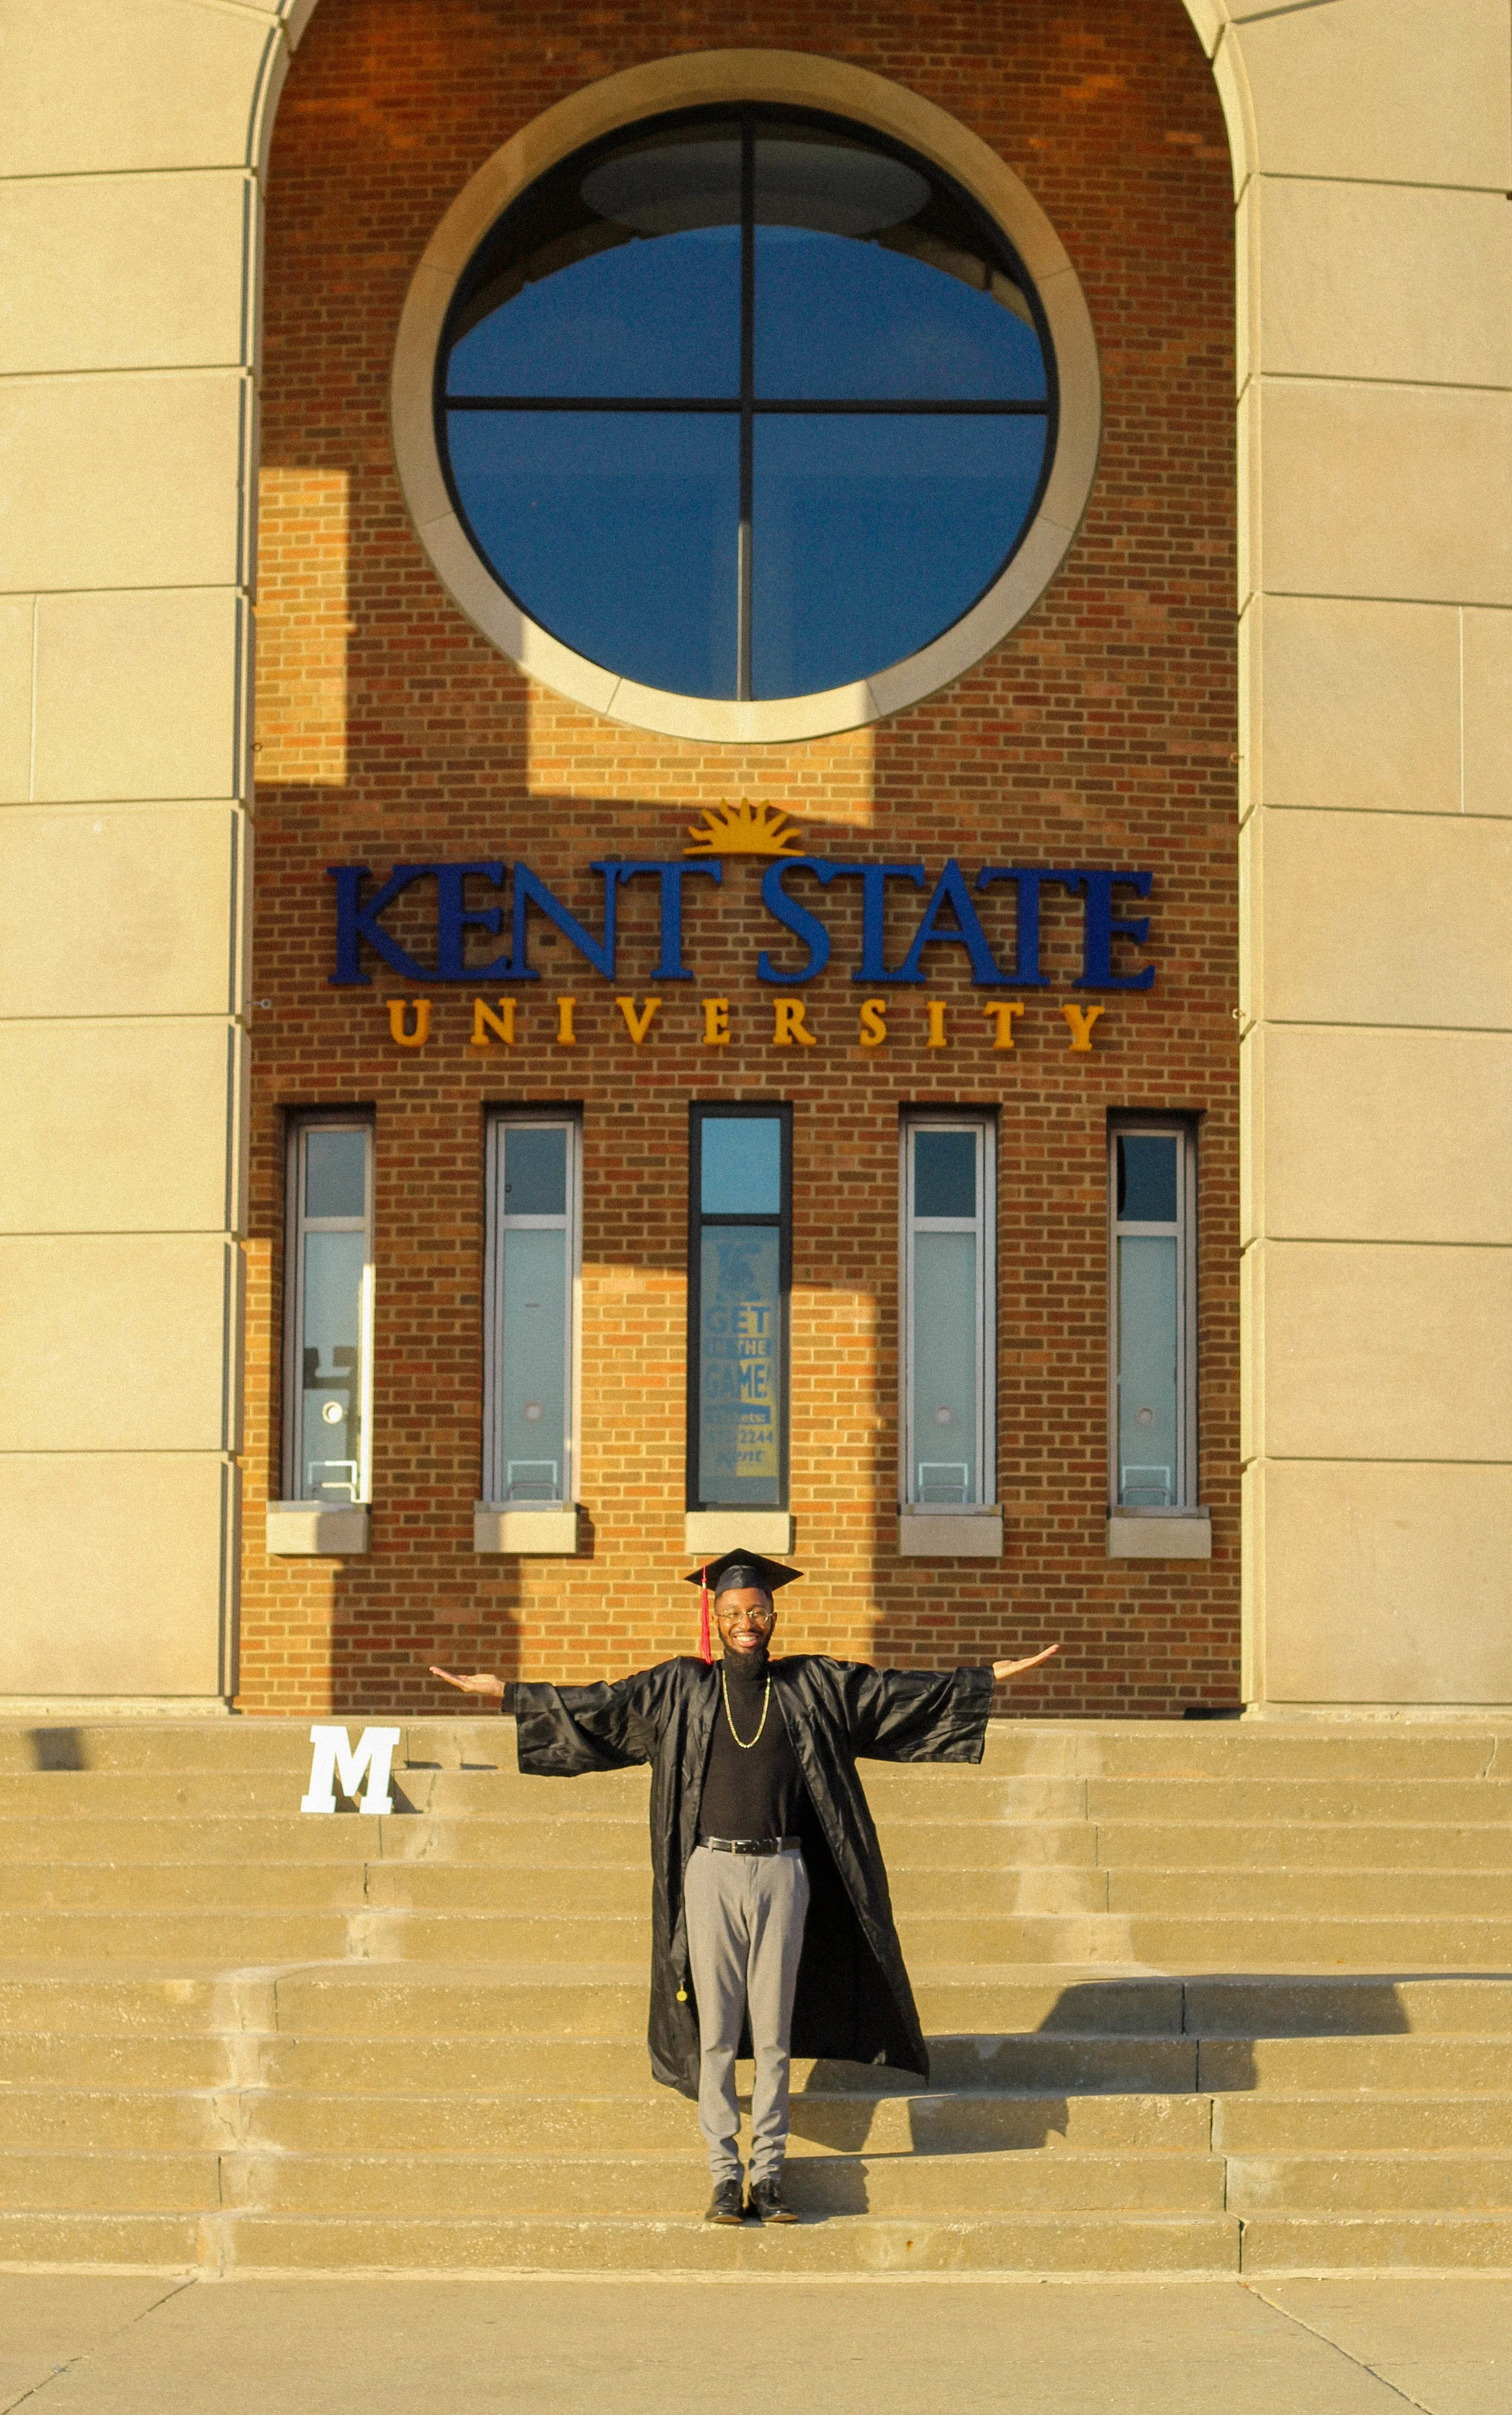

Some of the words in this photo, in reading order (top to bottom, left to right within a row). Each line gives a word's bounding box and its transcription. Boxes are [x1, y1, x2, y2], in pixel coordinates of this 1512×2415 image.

[327, 861, 722, 985] KENT
[757, 856, 1156, 989] STATE
[386, 996, 1105, 1052] UNIVERSITY
[705, 1305, 771, 1334] GET
[736, 1338, 767, 1355] THE
[300, 1725, 400, 1814] M
